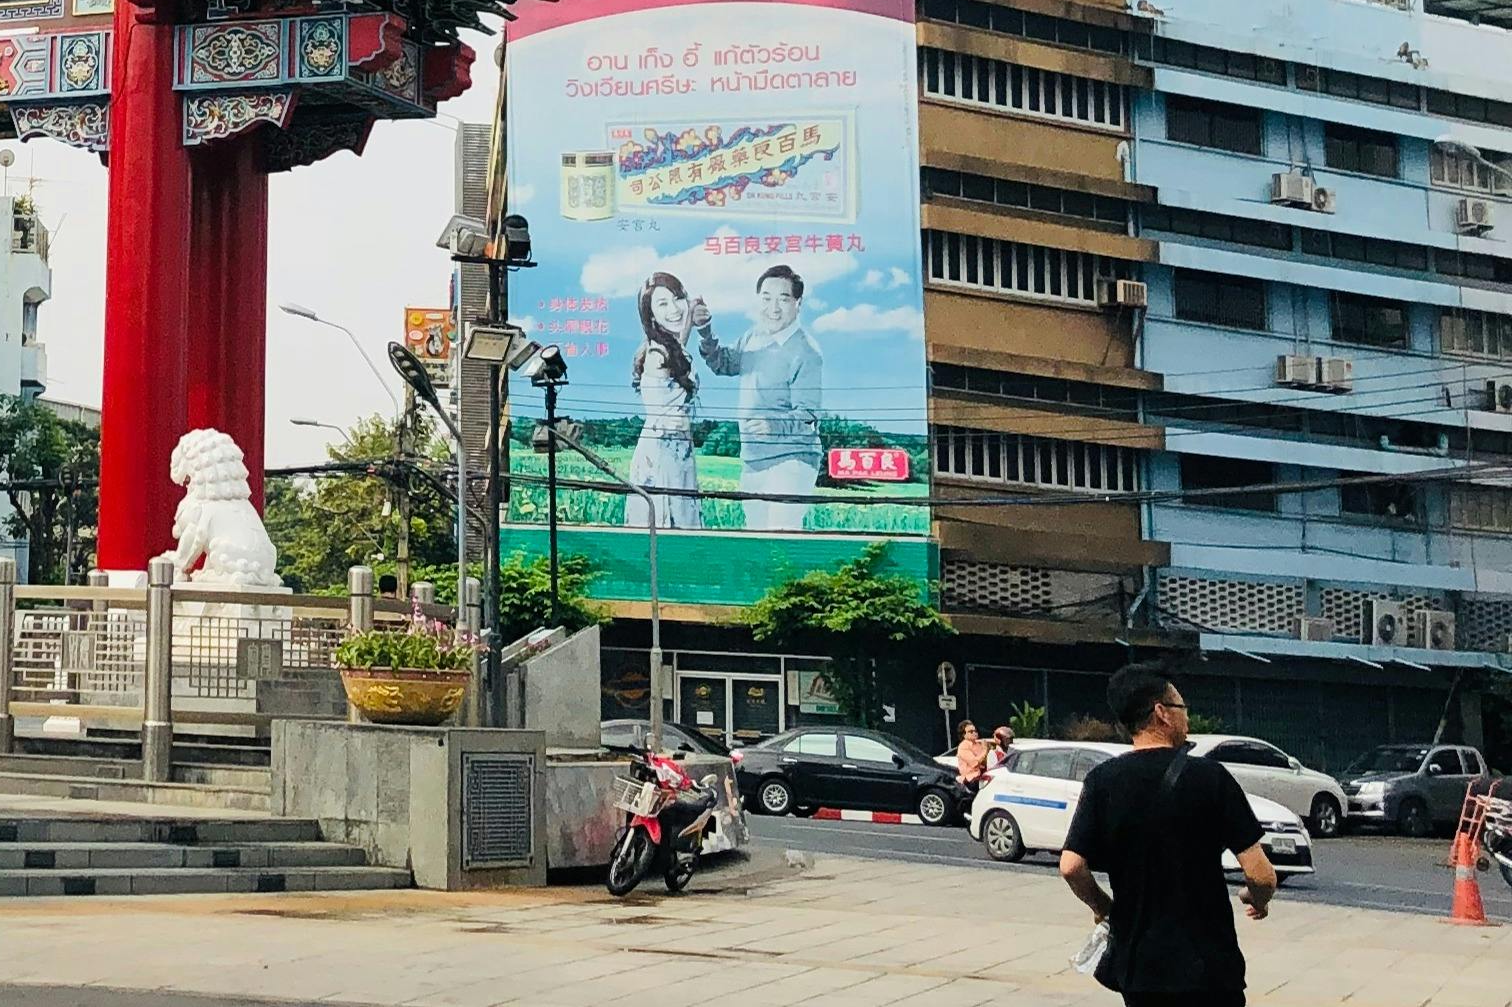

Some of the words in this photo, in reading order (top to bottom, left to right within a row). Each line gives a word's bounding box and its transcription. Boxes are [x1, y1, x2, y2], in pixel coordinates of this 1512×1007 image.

[586, 54, 629, 72] อาน
[714, 42, 821, 66] แก้ตัวร้อน
[710, 69, 857, 93] หน้ามืดตาลาย
